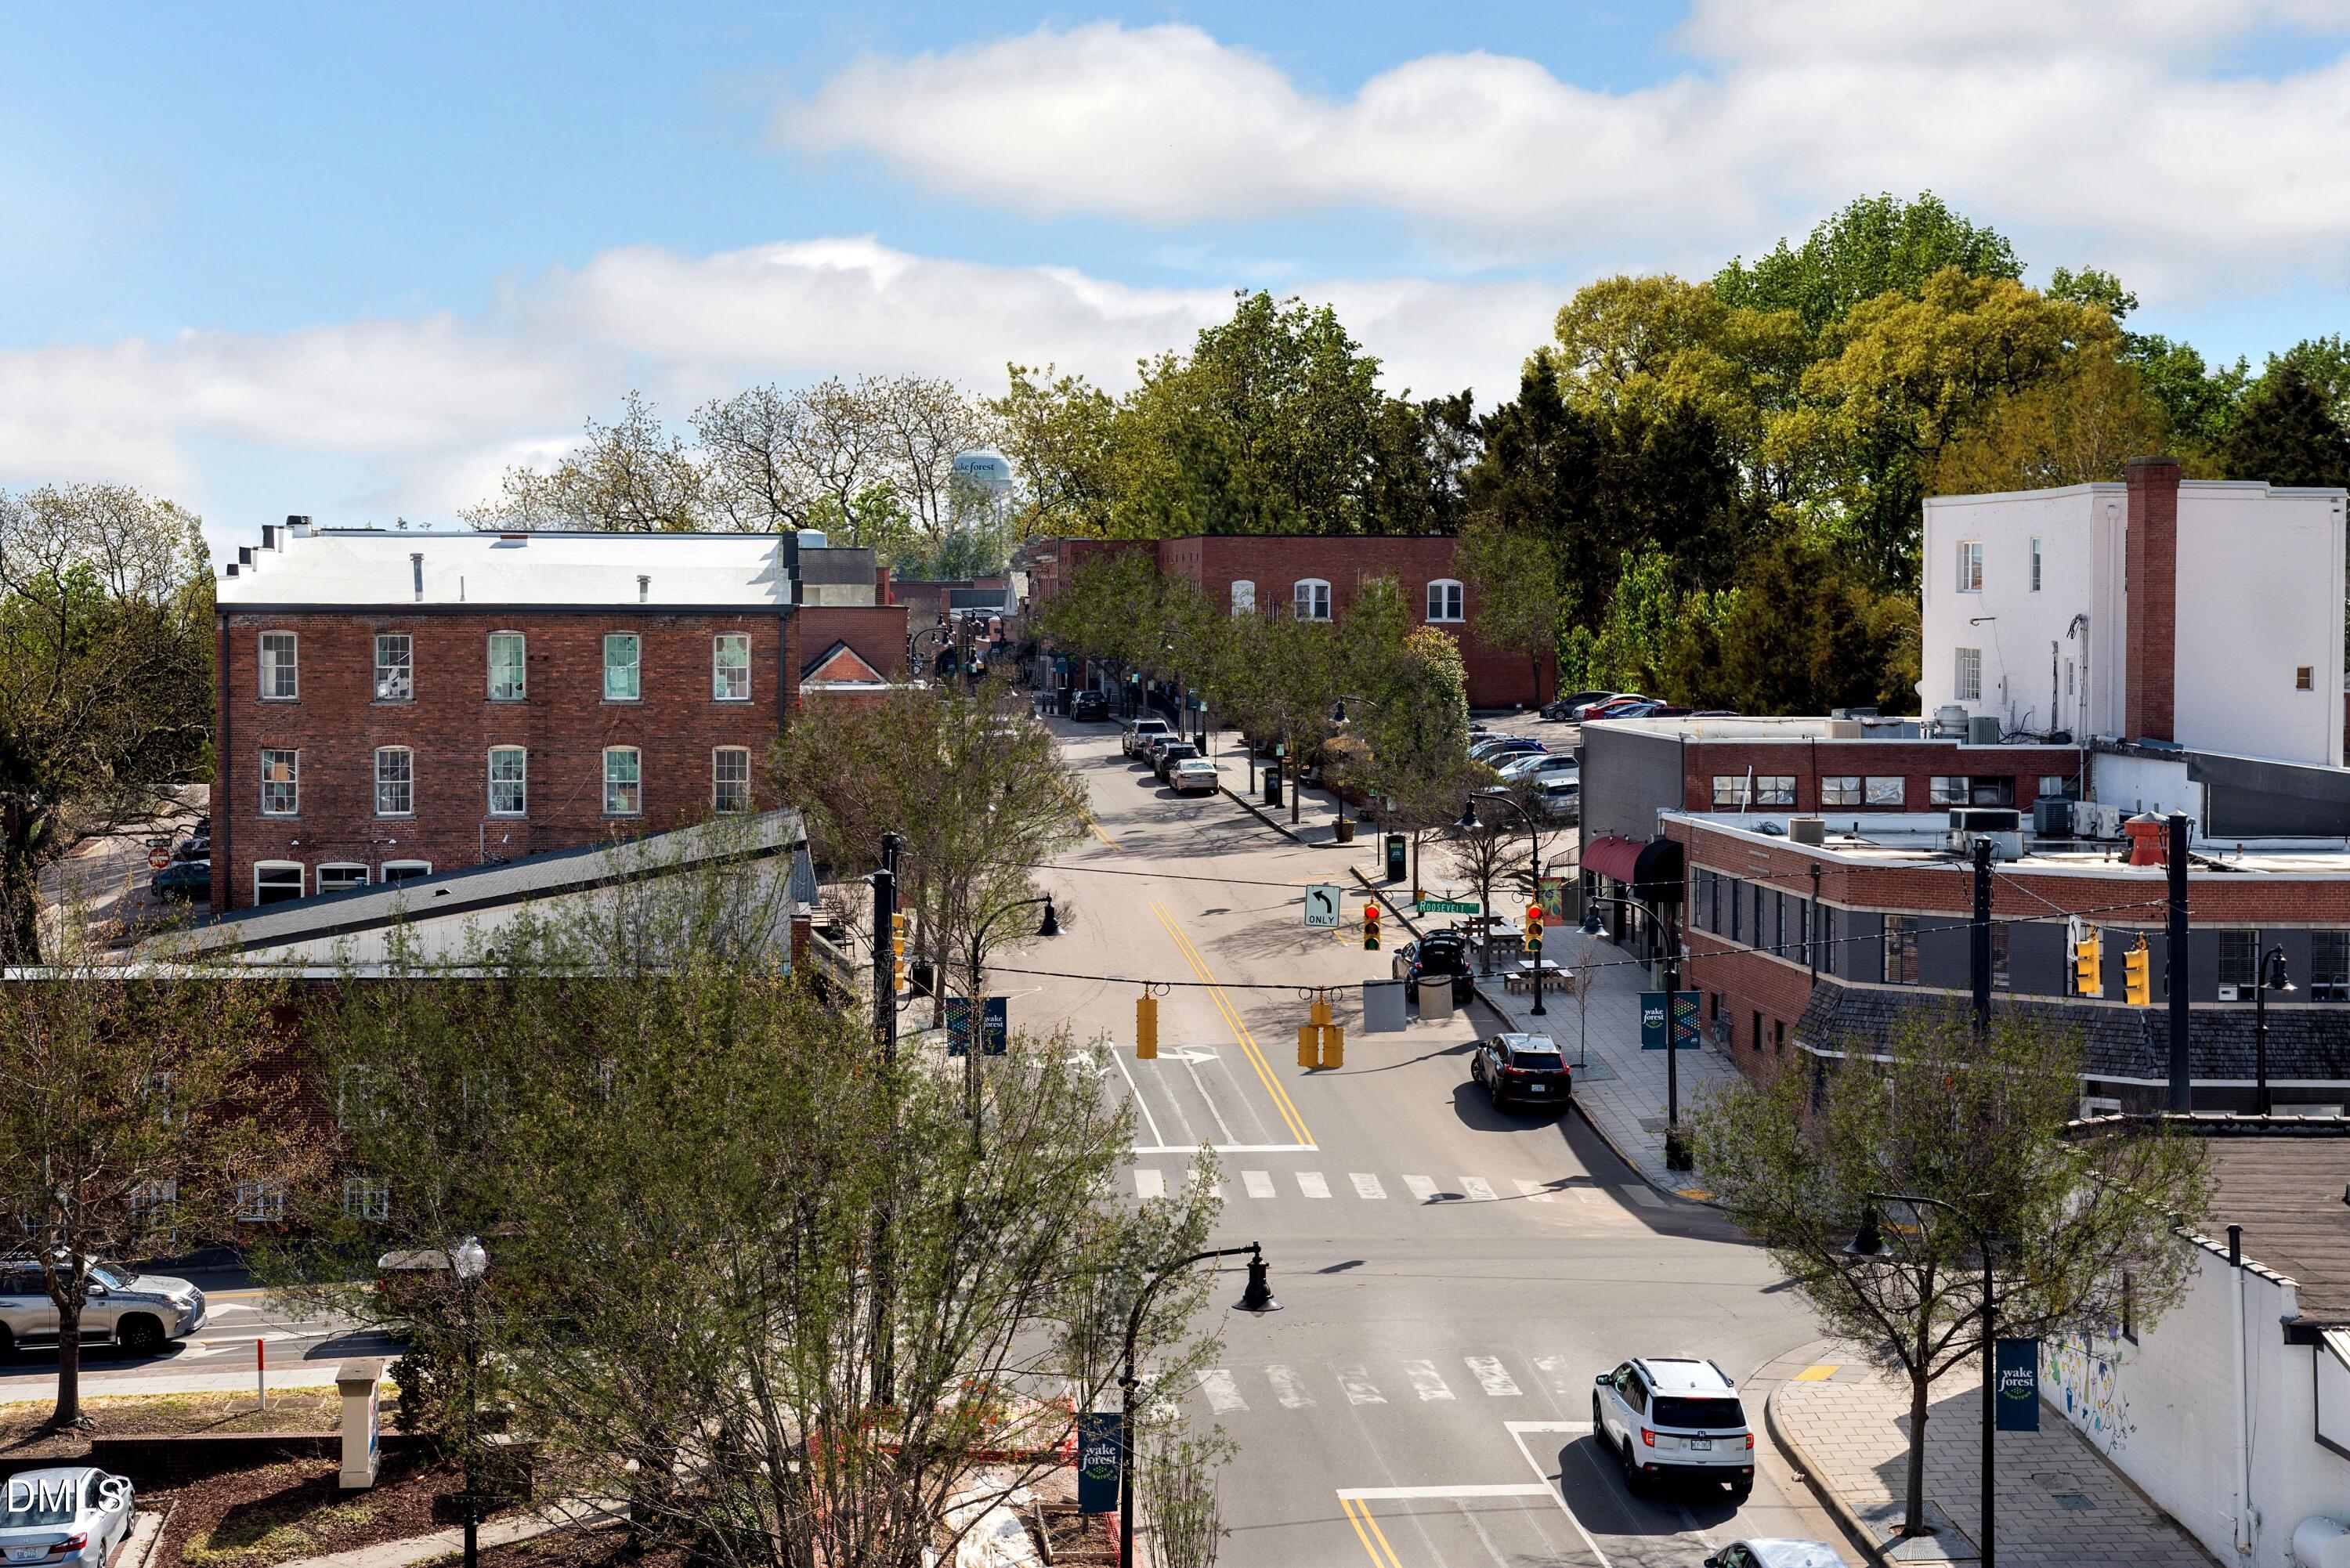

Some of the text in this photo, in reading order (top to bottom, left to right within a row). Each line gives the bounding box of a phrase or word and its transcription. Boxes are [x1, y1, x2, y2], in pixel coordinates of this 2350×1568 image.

[968, 461, 995, 475] forest
[1309, 915, 1335, 924] ONLY
[1643, 1013, 1664, 1024] forest
[2002, 1367, 2033, 1378] wake
[1998, 1376, 2034, 1392] forest
[1086, 1443, 1116, 1455] wake
[1079, 1453, 1117, 1472] forest
[1086, 1469, 1114, 1479] DOWNTOWN
